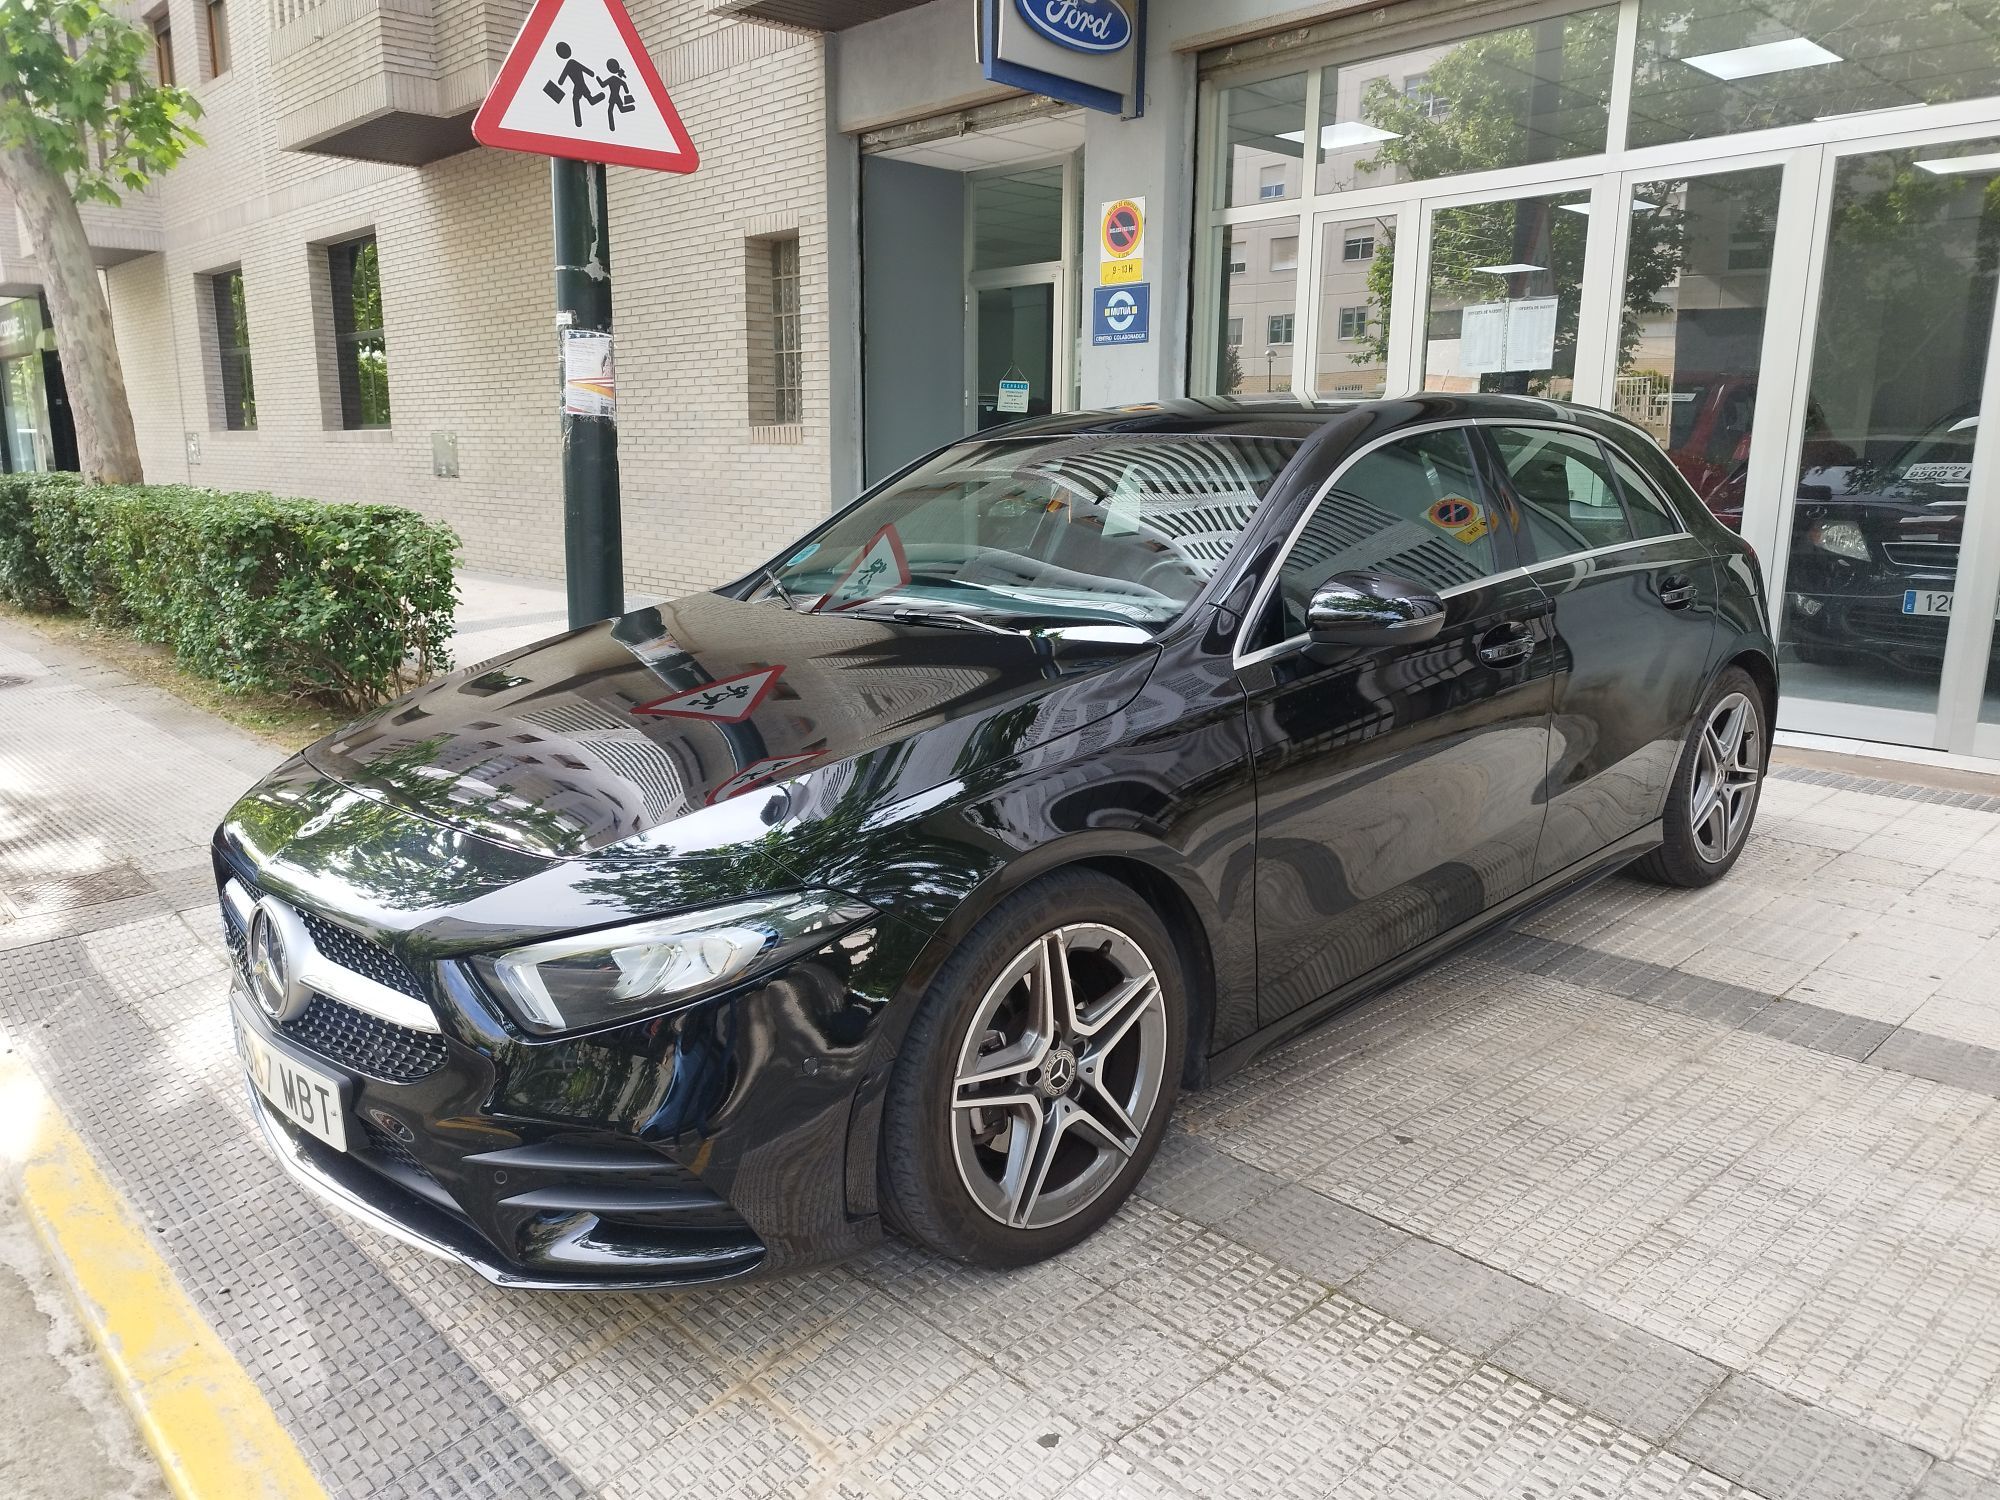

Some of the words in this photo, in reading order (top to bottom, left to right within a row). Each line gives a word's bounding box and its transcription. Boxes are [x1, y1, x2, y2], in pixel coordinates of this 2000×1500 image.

[1045, 0, 1113, 39] Ford
[1095, 334, 1112, 342] CENTRO
[1113, 332, 1146, 341] COLABORADOR
[1951, 470, 1963, 478] €
[278, 1062, 331, 1136] MBT
